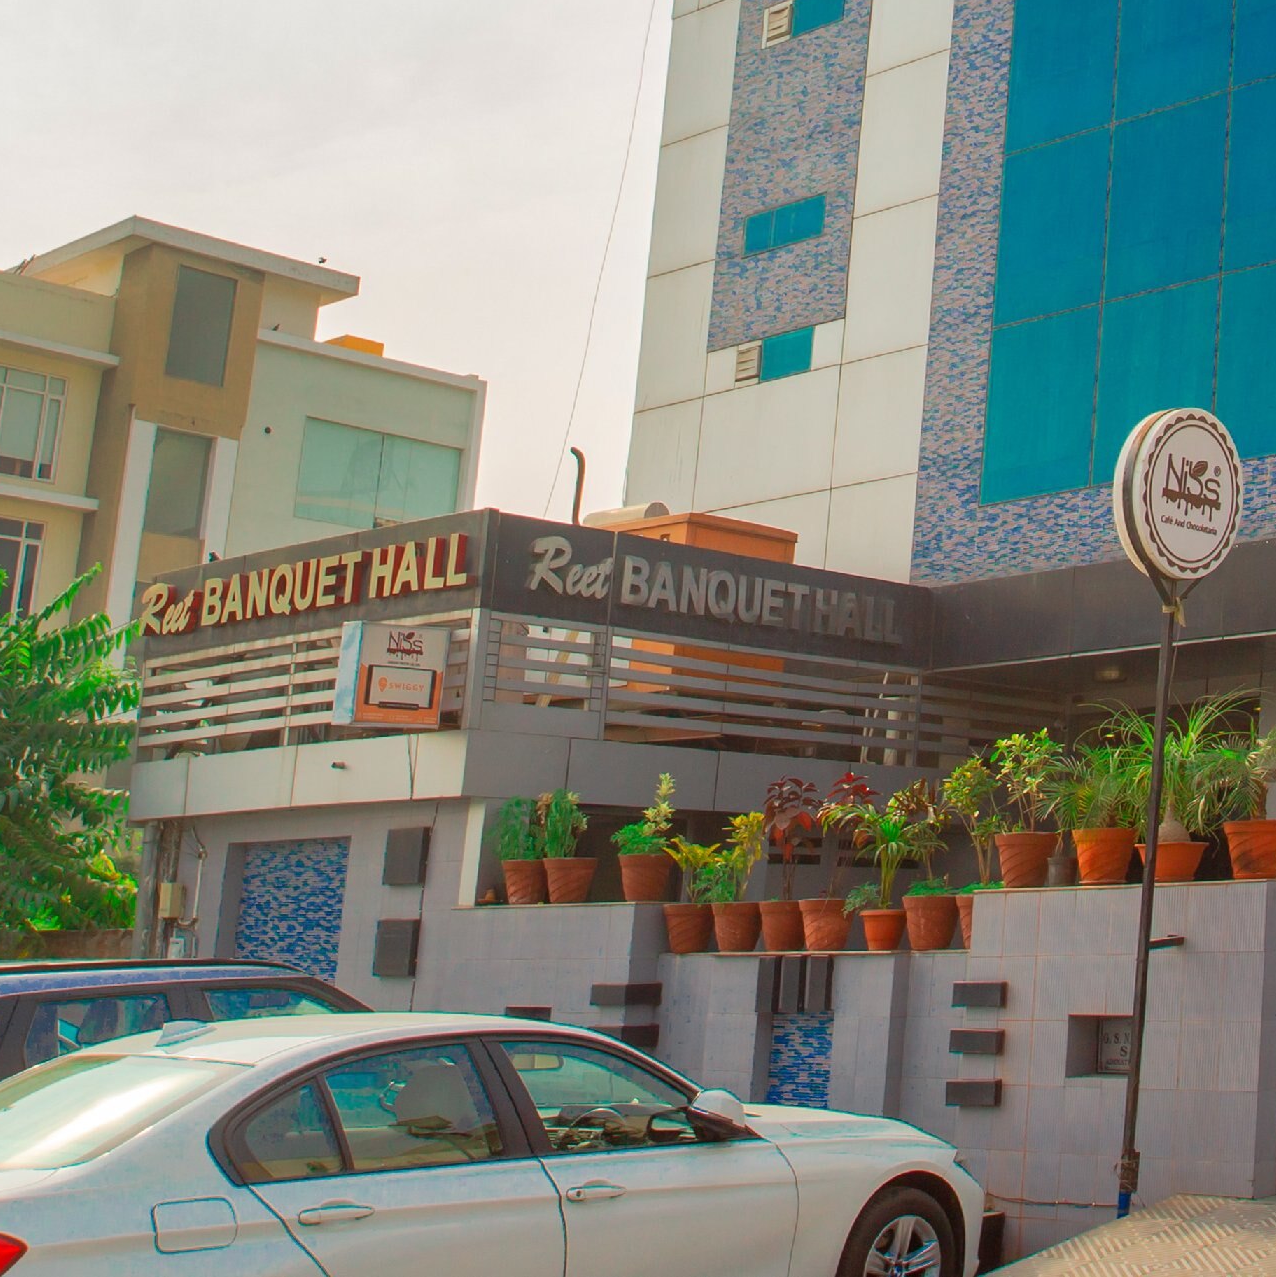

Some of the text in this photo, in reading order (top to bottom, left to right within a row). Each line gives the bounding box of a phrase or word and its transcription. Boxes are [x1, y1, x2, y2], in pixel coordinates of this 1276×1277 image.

[141, 533, 476, 637] Reet BANQUET HALL
[529, 535, 904, 645] Reet BANQUET HALL
[389, 682, 425, 692] SWIGGY
